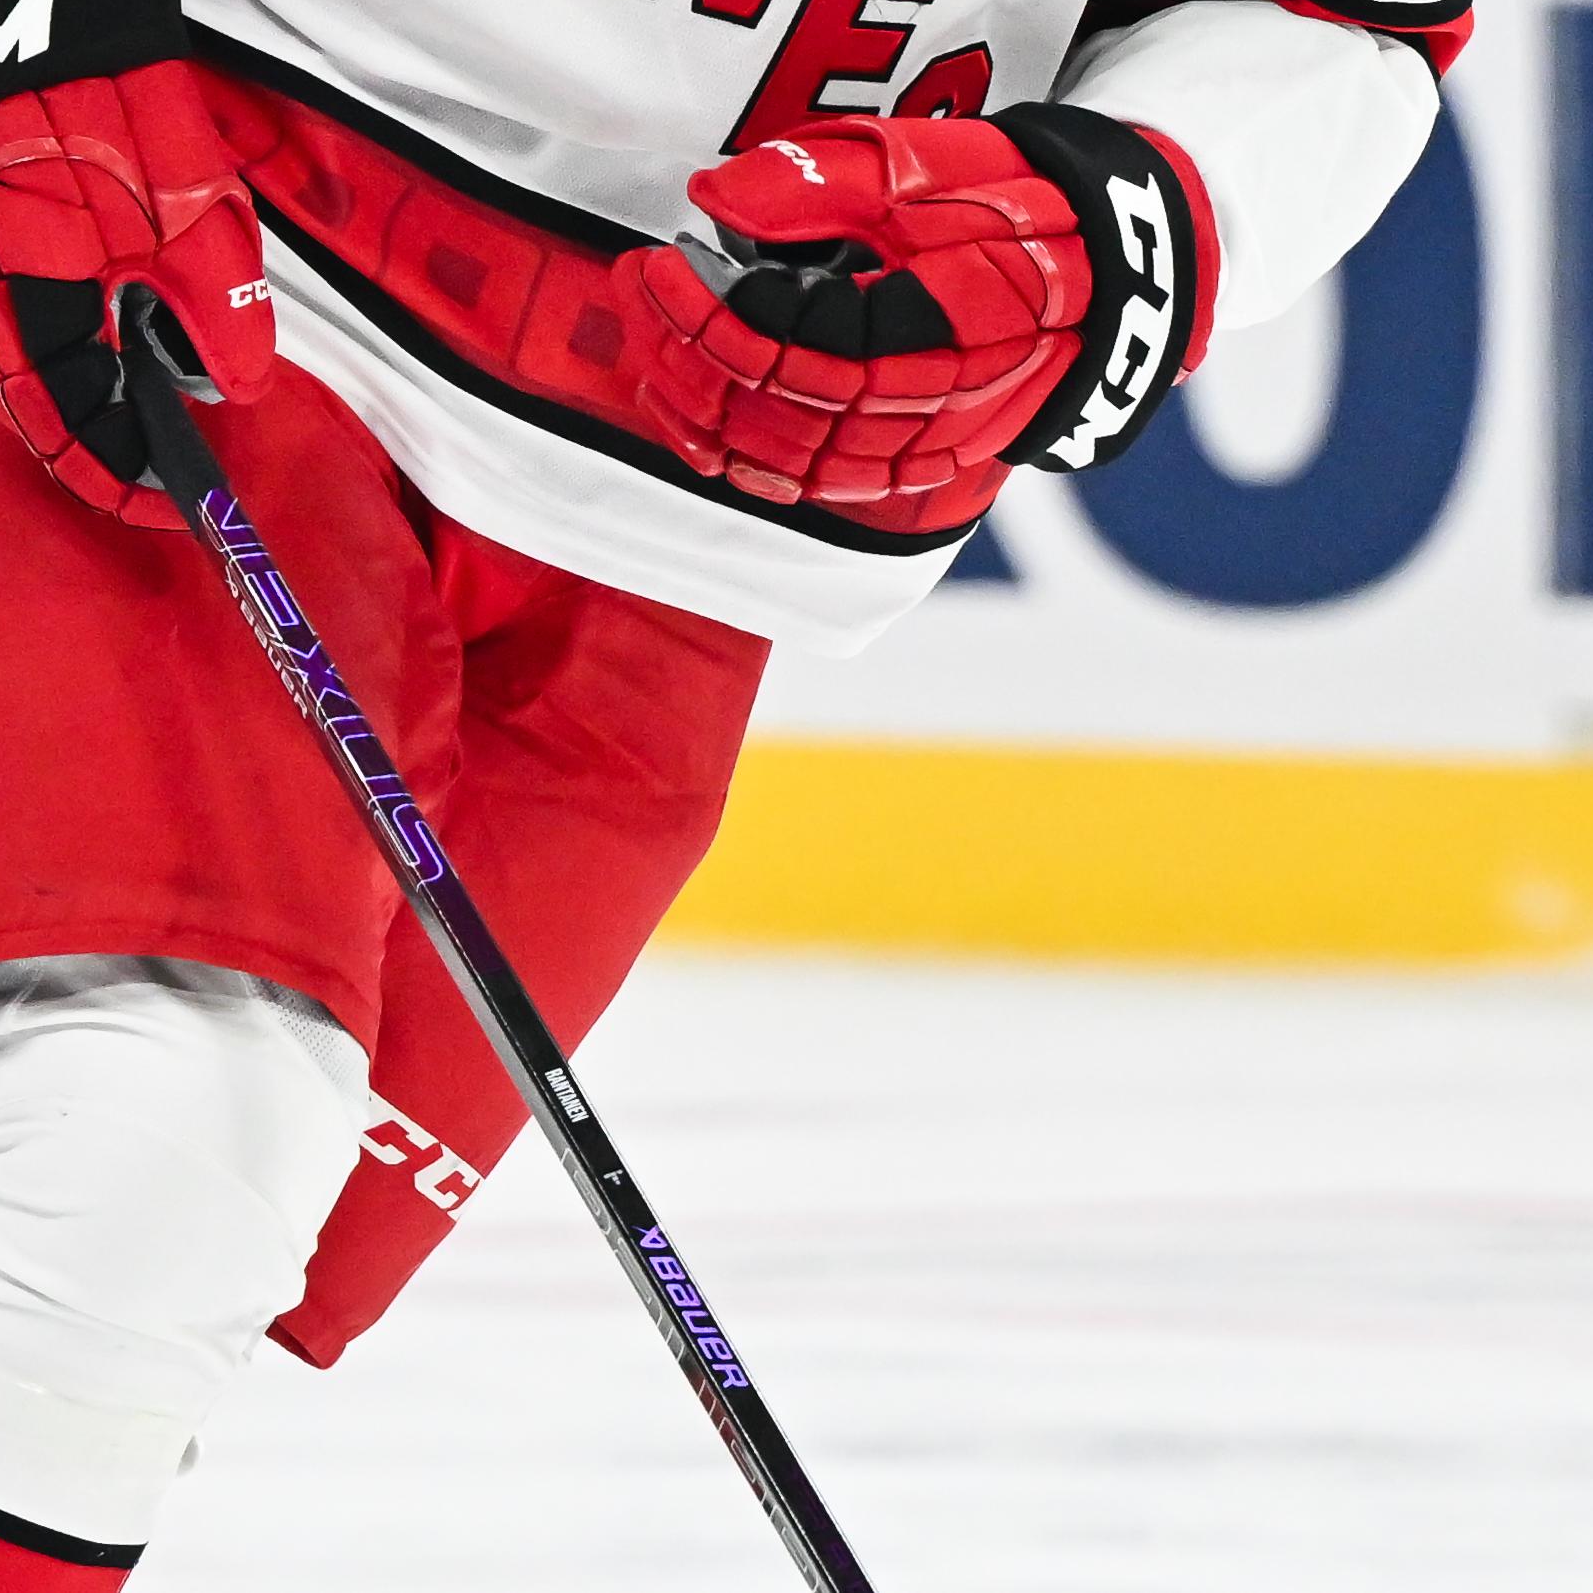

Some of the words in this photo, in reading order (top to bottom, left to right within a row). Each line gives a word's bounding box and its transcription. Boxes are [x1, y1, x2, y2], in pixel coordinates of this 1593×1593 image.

[227, 278, 271, 310] CC
[1046, 172, 1175, 469] CCM
[358, 1089, 484, 1222] CC
[544, 1067, 590, 1124] RANTANEN
[649, 1254, 750, 1391] BAUER
